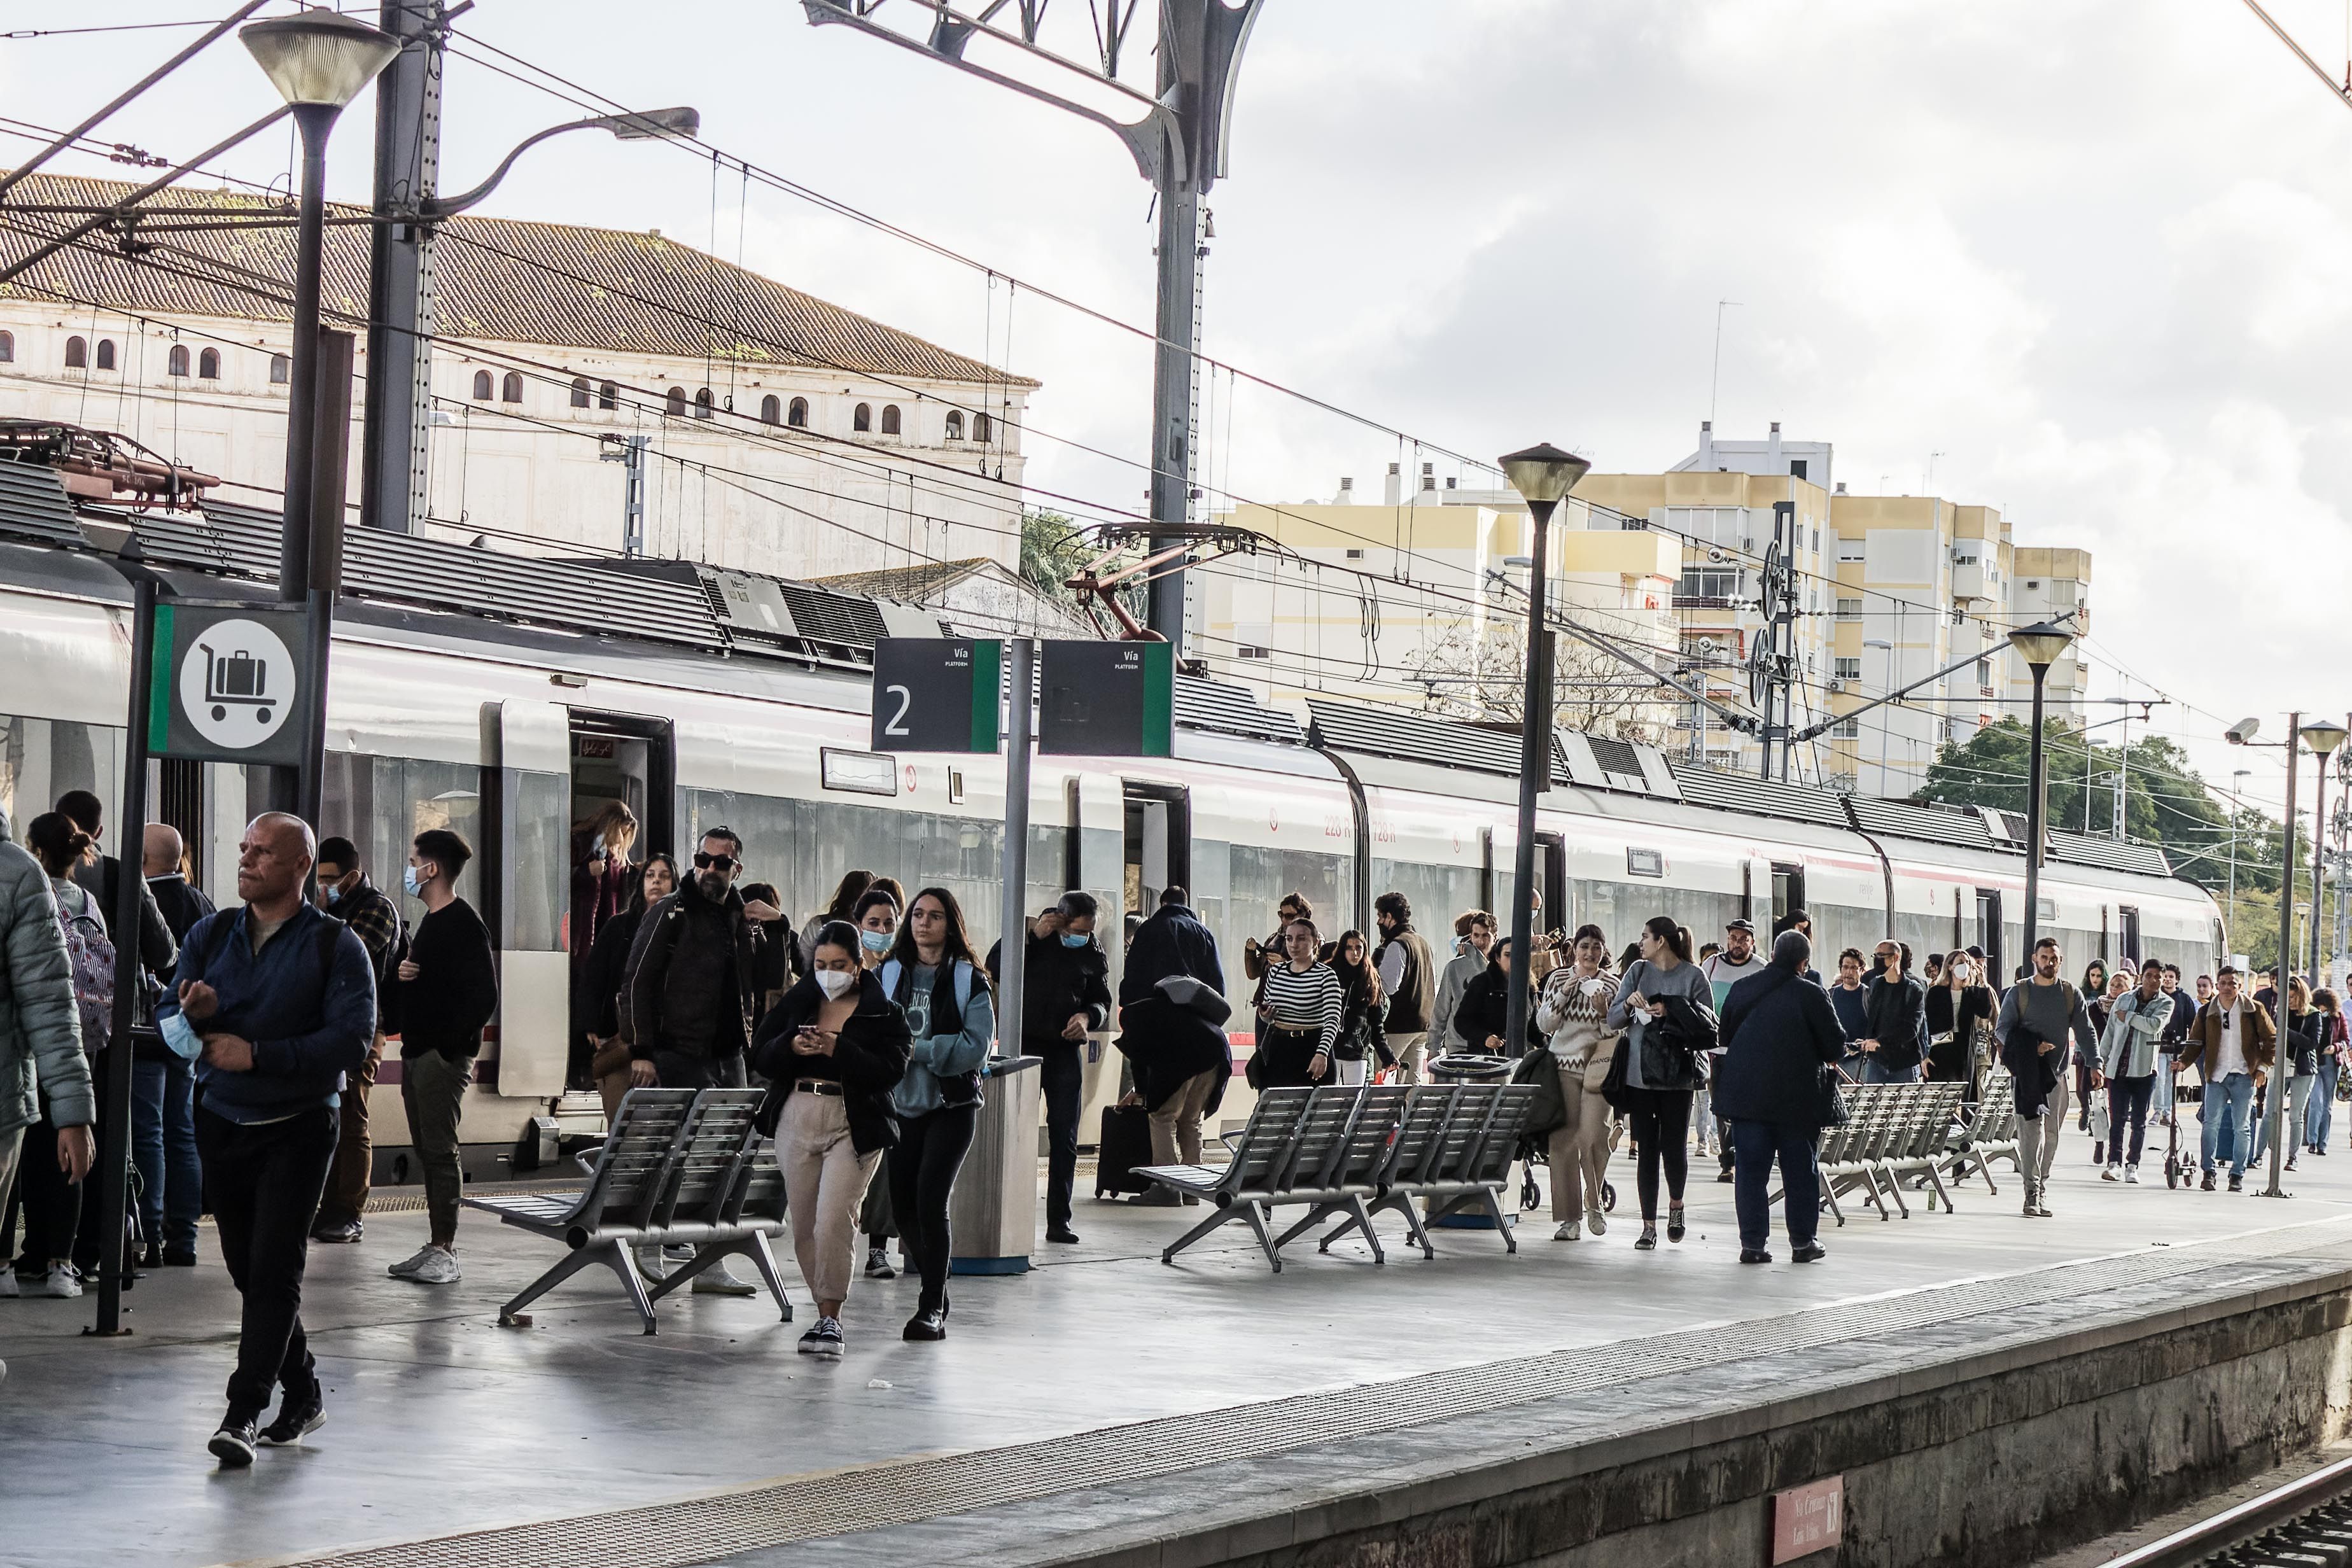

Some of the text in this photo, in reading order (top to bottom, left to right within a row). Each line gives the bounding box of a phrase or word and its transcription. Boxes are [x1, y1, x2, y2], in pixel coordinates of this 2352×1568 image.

[954, 648, 969, 658] Vía
[1124, 650, 1138, 661] Vía
[885, 685, 911, 736] 2
[1343, 817, 1350, 838] R
[1390, 823, 1396, 843] R
[1589, 1056, 1611, 1066] MANG
